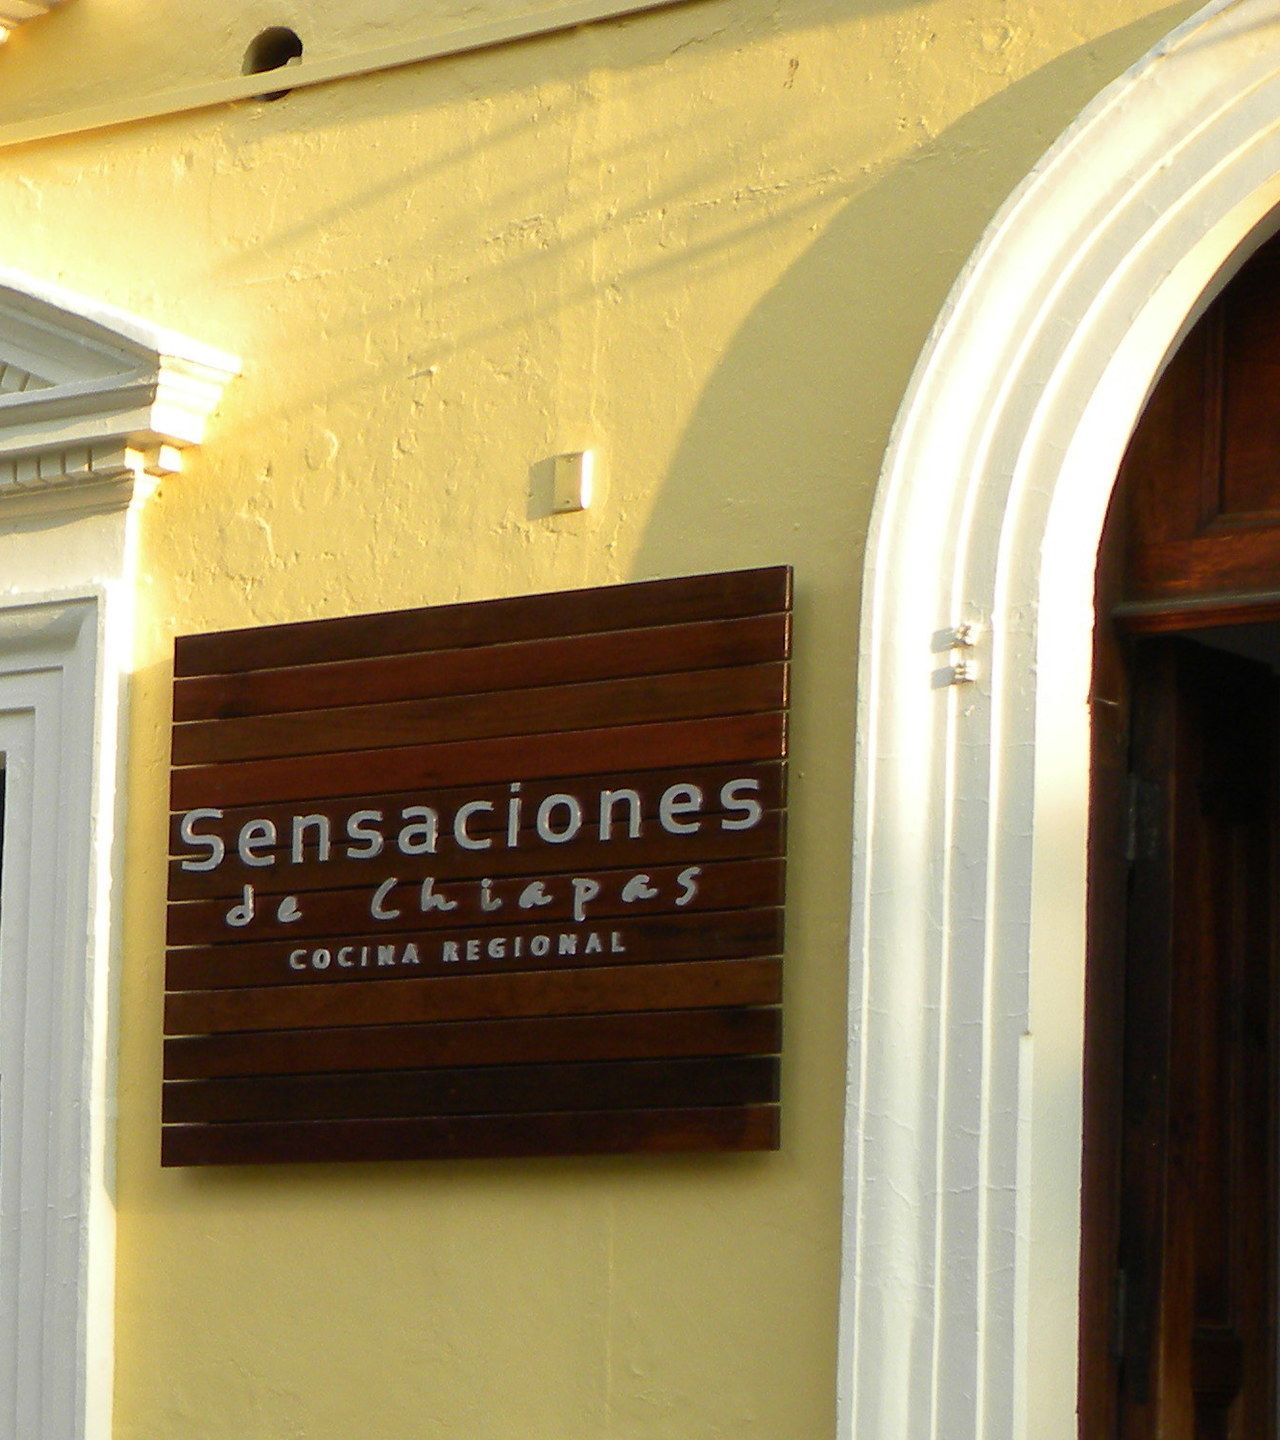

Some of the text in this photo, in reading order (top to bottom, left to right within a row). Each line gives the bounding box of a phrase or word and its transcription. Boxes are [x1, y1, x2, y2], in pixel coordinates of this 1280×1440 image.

[179, 776, 763, 873] Sensaciones
[225, 866, 703, 928] de Chiapas
[288, 931, 628, 971] COCINA REGIONAL
